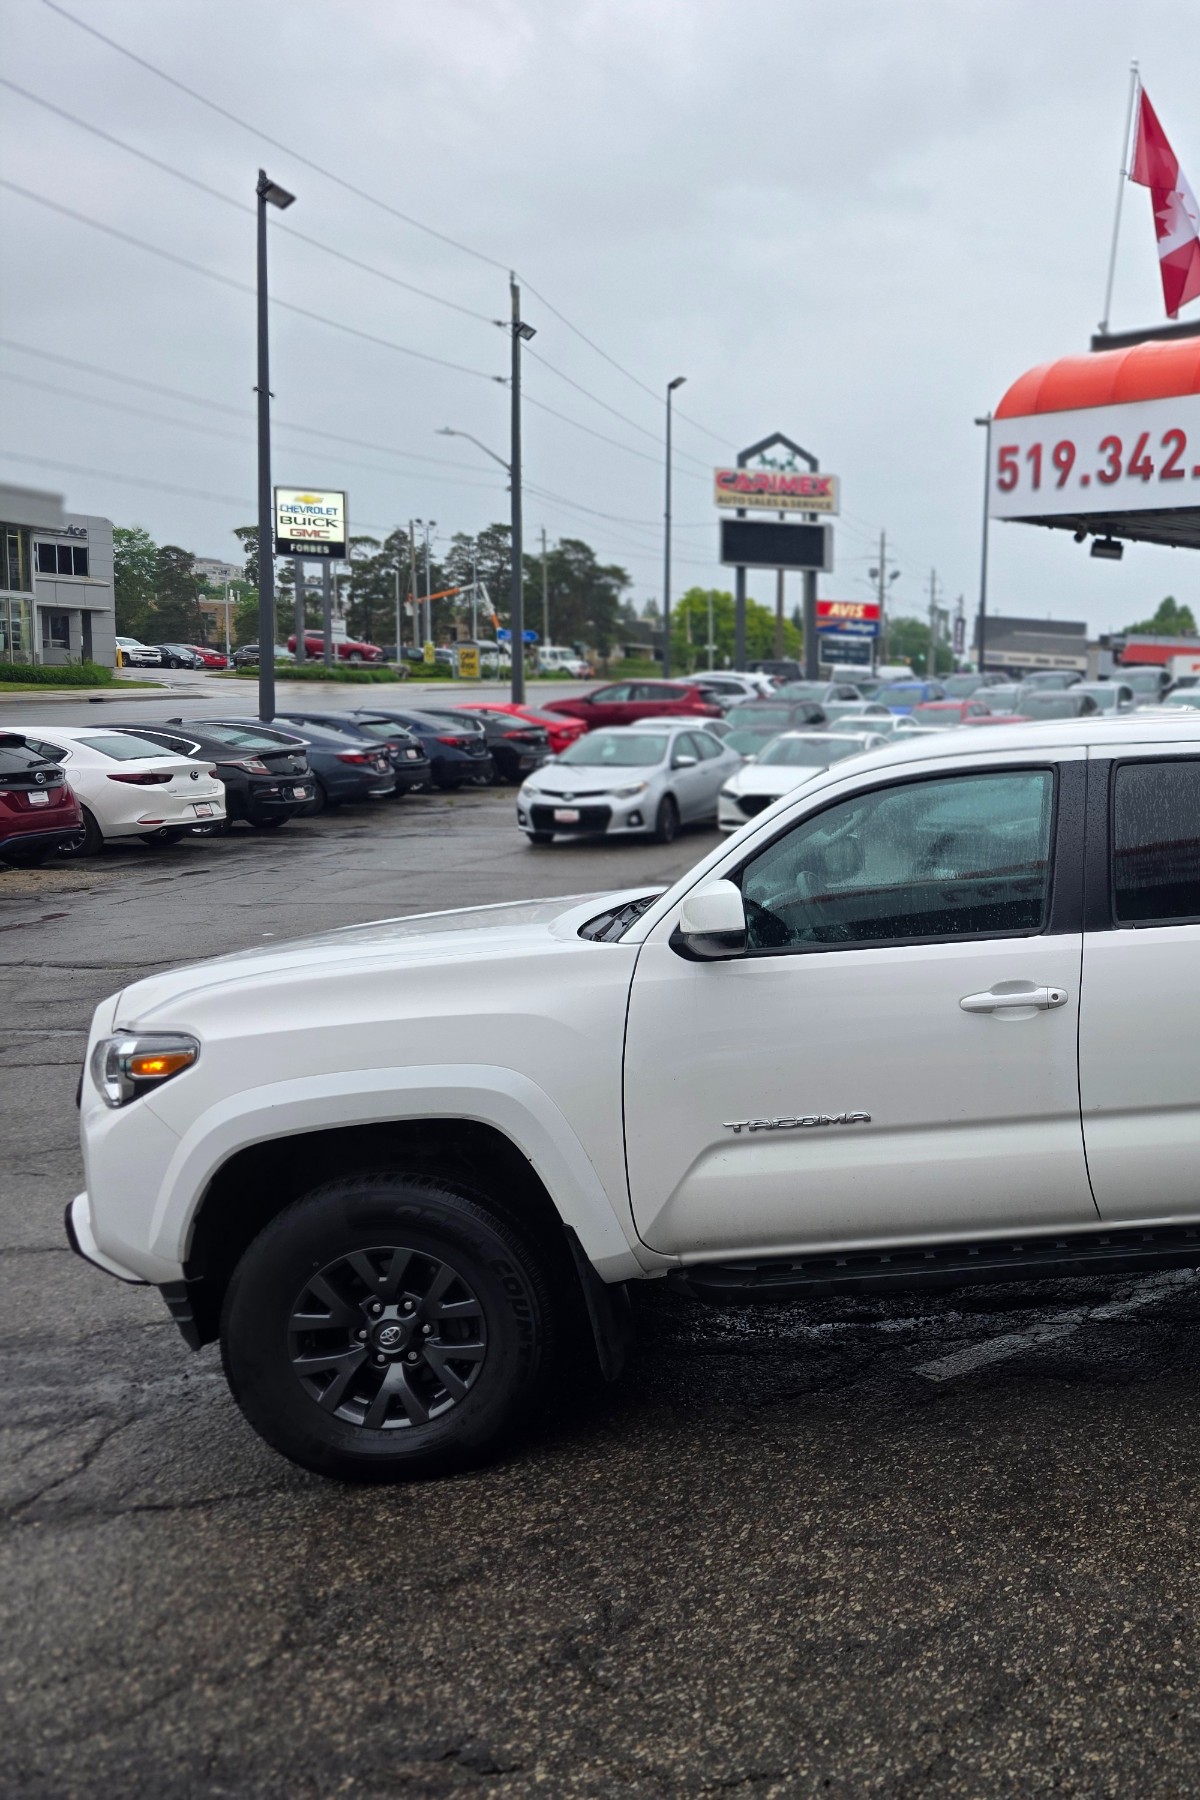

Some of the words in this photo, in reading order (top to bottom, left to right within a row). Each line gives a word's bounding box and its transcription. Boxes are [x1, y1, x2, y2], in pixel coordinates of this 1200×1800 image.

[715, 470, 832, 498] CARIMEX
[717, 496, 746, 505] AUTO
[748, 497, 778, 507] SALES
[780, 499, 789, 508] &
[791, 500, 832, 510] SERVICE
[279, 504, 339, 517] CHEVROLET
[279, 515, 339, 529] BUICK
[289, 528, 331, 540] GMC
[290, 543, 330, 554] FORBES
[828, 602, 865, 619] AVIS
[722, 1110, 872, 1133] TACOMA
